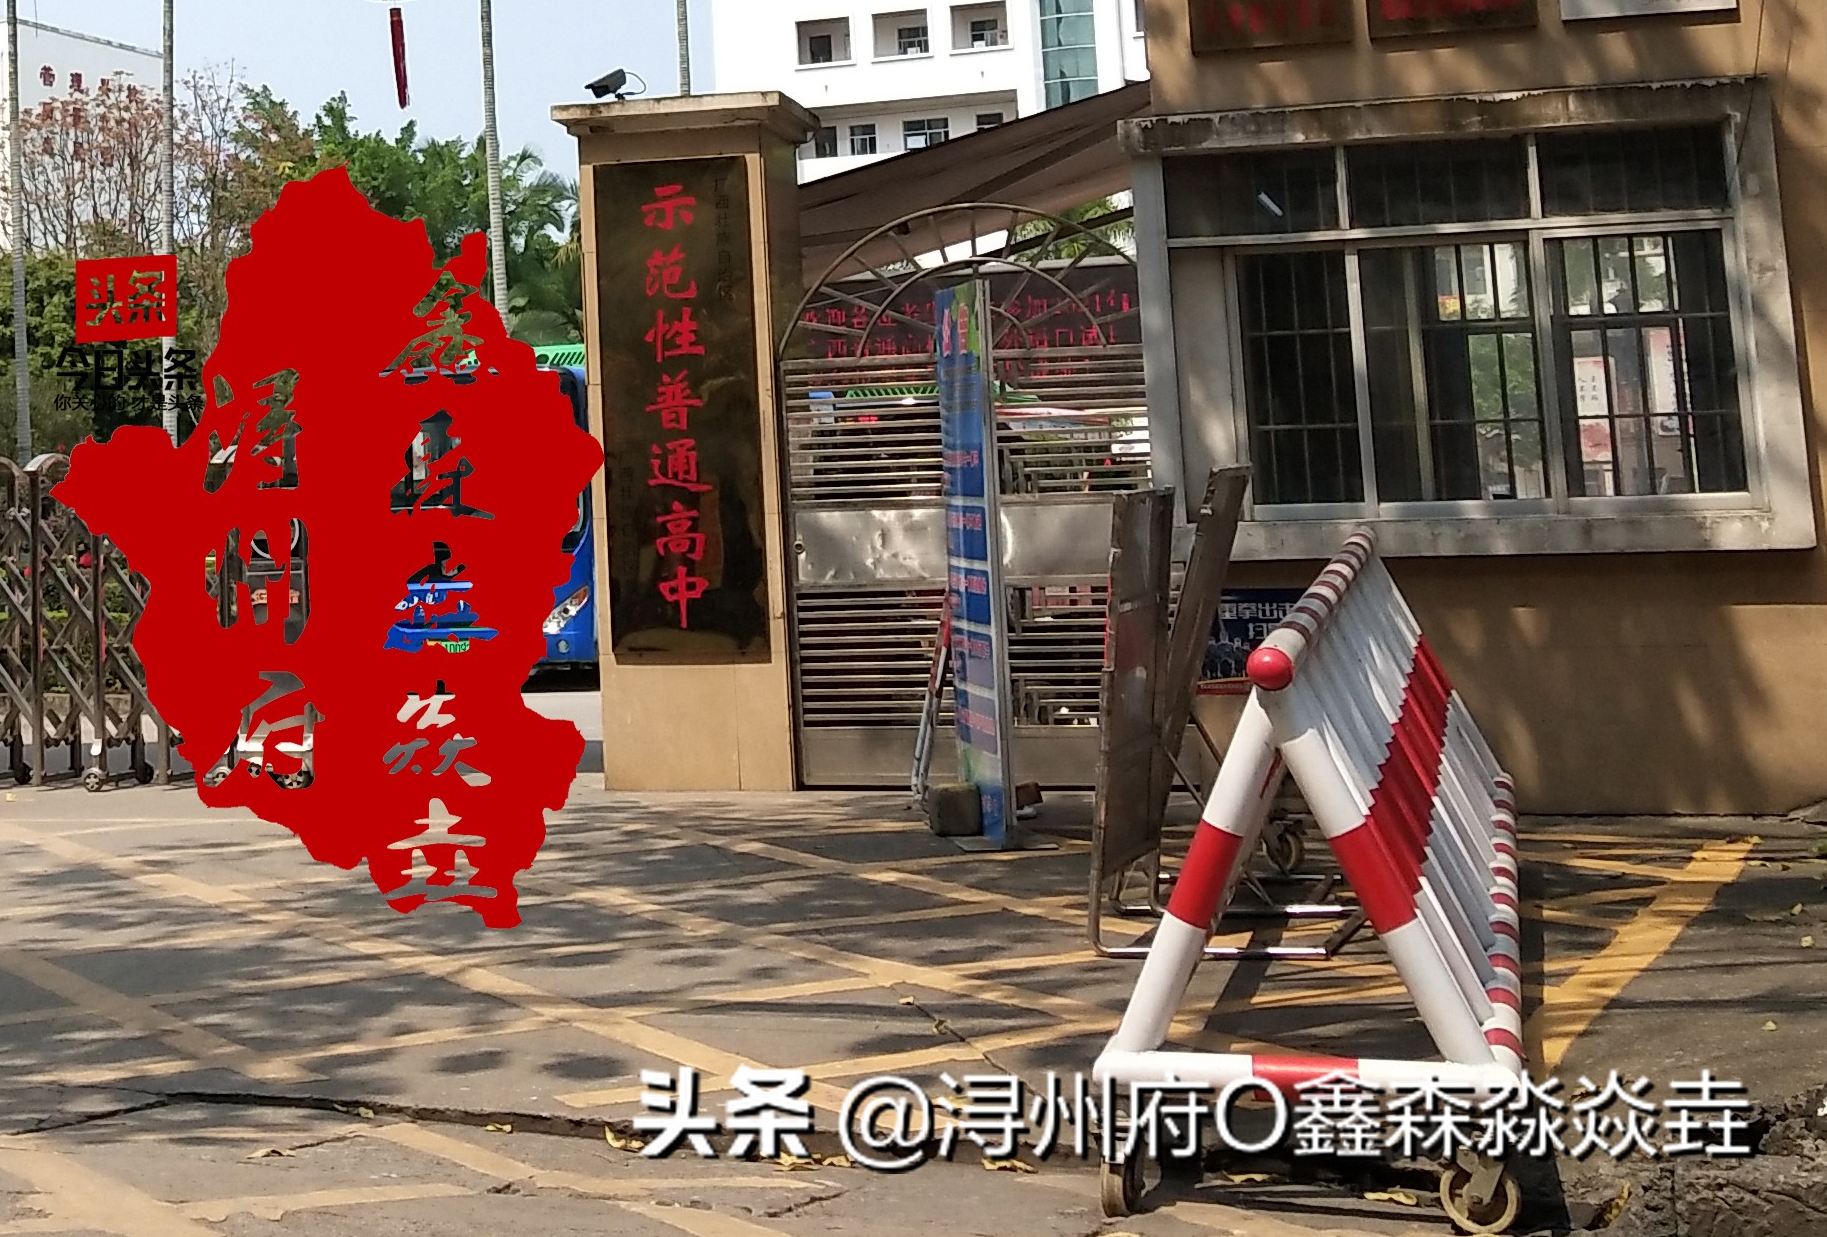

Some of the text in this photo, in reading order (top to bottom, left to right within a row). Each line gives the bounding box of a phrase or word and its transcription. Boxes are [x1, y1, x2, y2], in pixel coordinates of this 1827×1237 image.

[641, 184, 714, 629] 示范性普通高中
[1247, 623, 1278, 640] 扫
